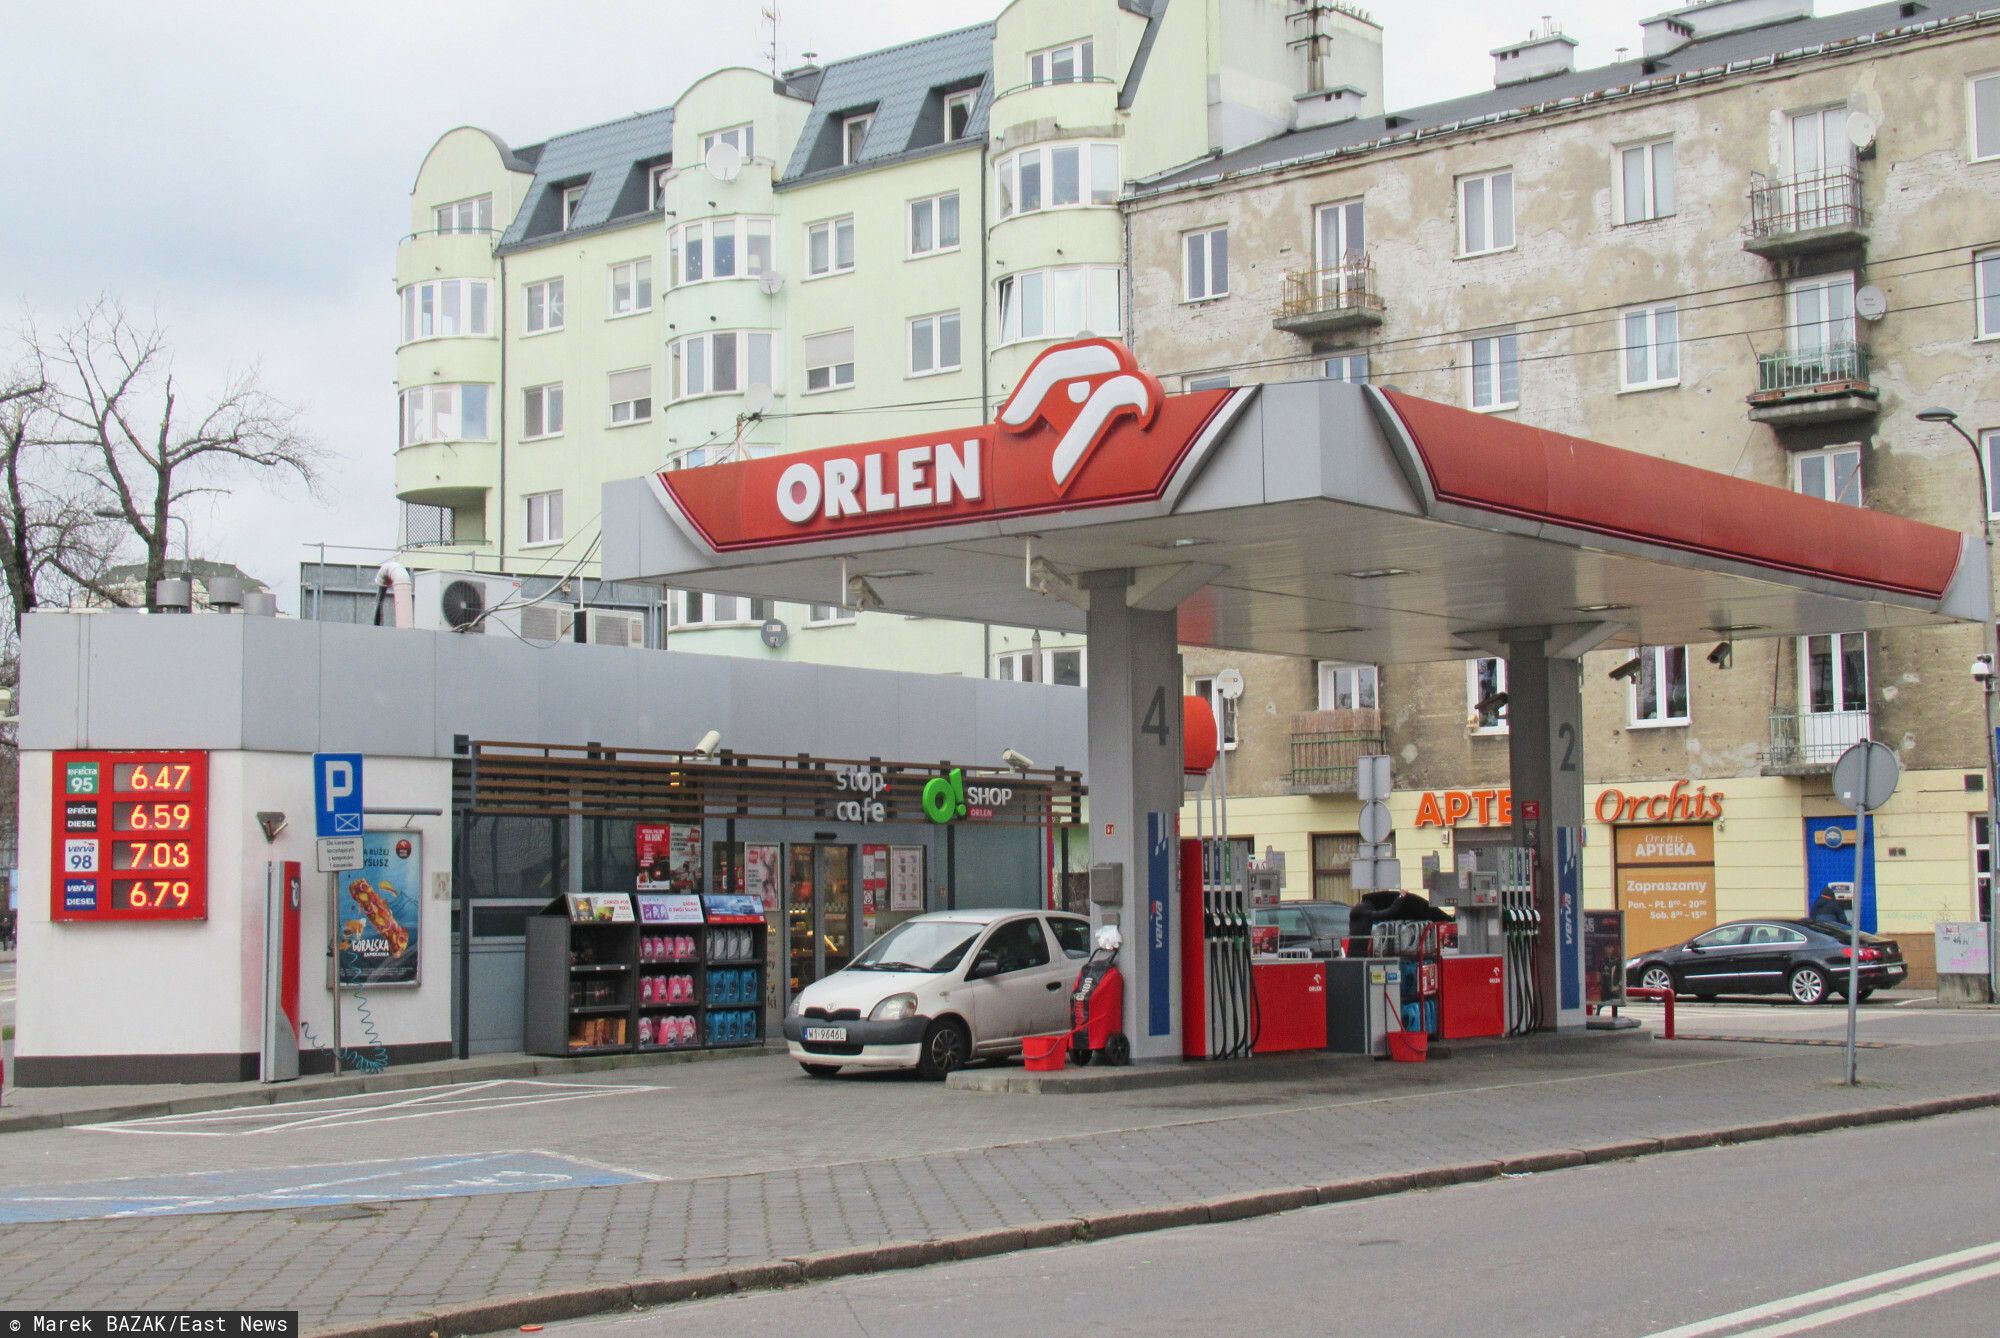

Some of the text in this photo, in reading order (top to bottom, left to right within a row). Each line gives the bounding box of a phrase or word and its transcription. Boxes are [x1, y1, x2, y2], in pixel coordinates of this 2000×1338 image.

[776, 438, 984, 525] ORLEN
[1141, 685, 1170, 746] 4
[1558, 721, 1577, 772] 2
[67, 766, 98, 776] efecta
[130, 765, 192, 790] 6.47
[71, 777, 94, 792] 95
[325, 760, 354, 812] P
[967, 786, 1013, 806] SHOP
[1594, 777, 1725, 825] Orchis
[67, 804, 97, 815] efecta
[130, 804, 191, 830] 6.59
[836, 797, 885, 825] cafe
[970, 808, 993, 817] ORLEN
[67, 820, 97, 828] DIESEL
[67, 844, 95, 853] verva
[130, 843, 190, 868] 7.03
[1635, 842, 1697, 857] APTEKA
[70, 855, 93, 869] 98
[66, 882, 95, 892] verva
[130, 882, 190, 907] 6.79
[1626, 880, 1707, 894] Zapraszamy
[66, 897, 96, 906] DIESEL
[1627, 900, 1647, 909] Pon.
[820, 1029, 845, 1040] 9646L
